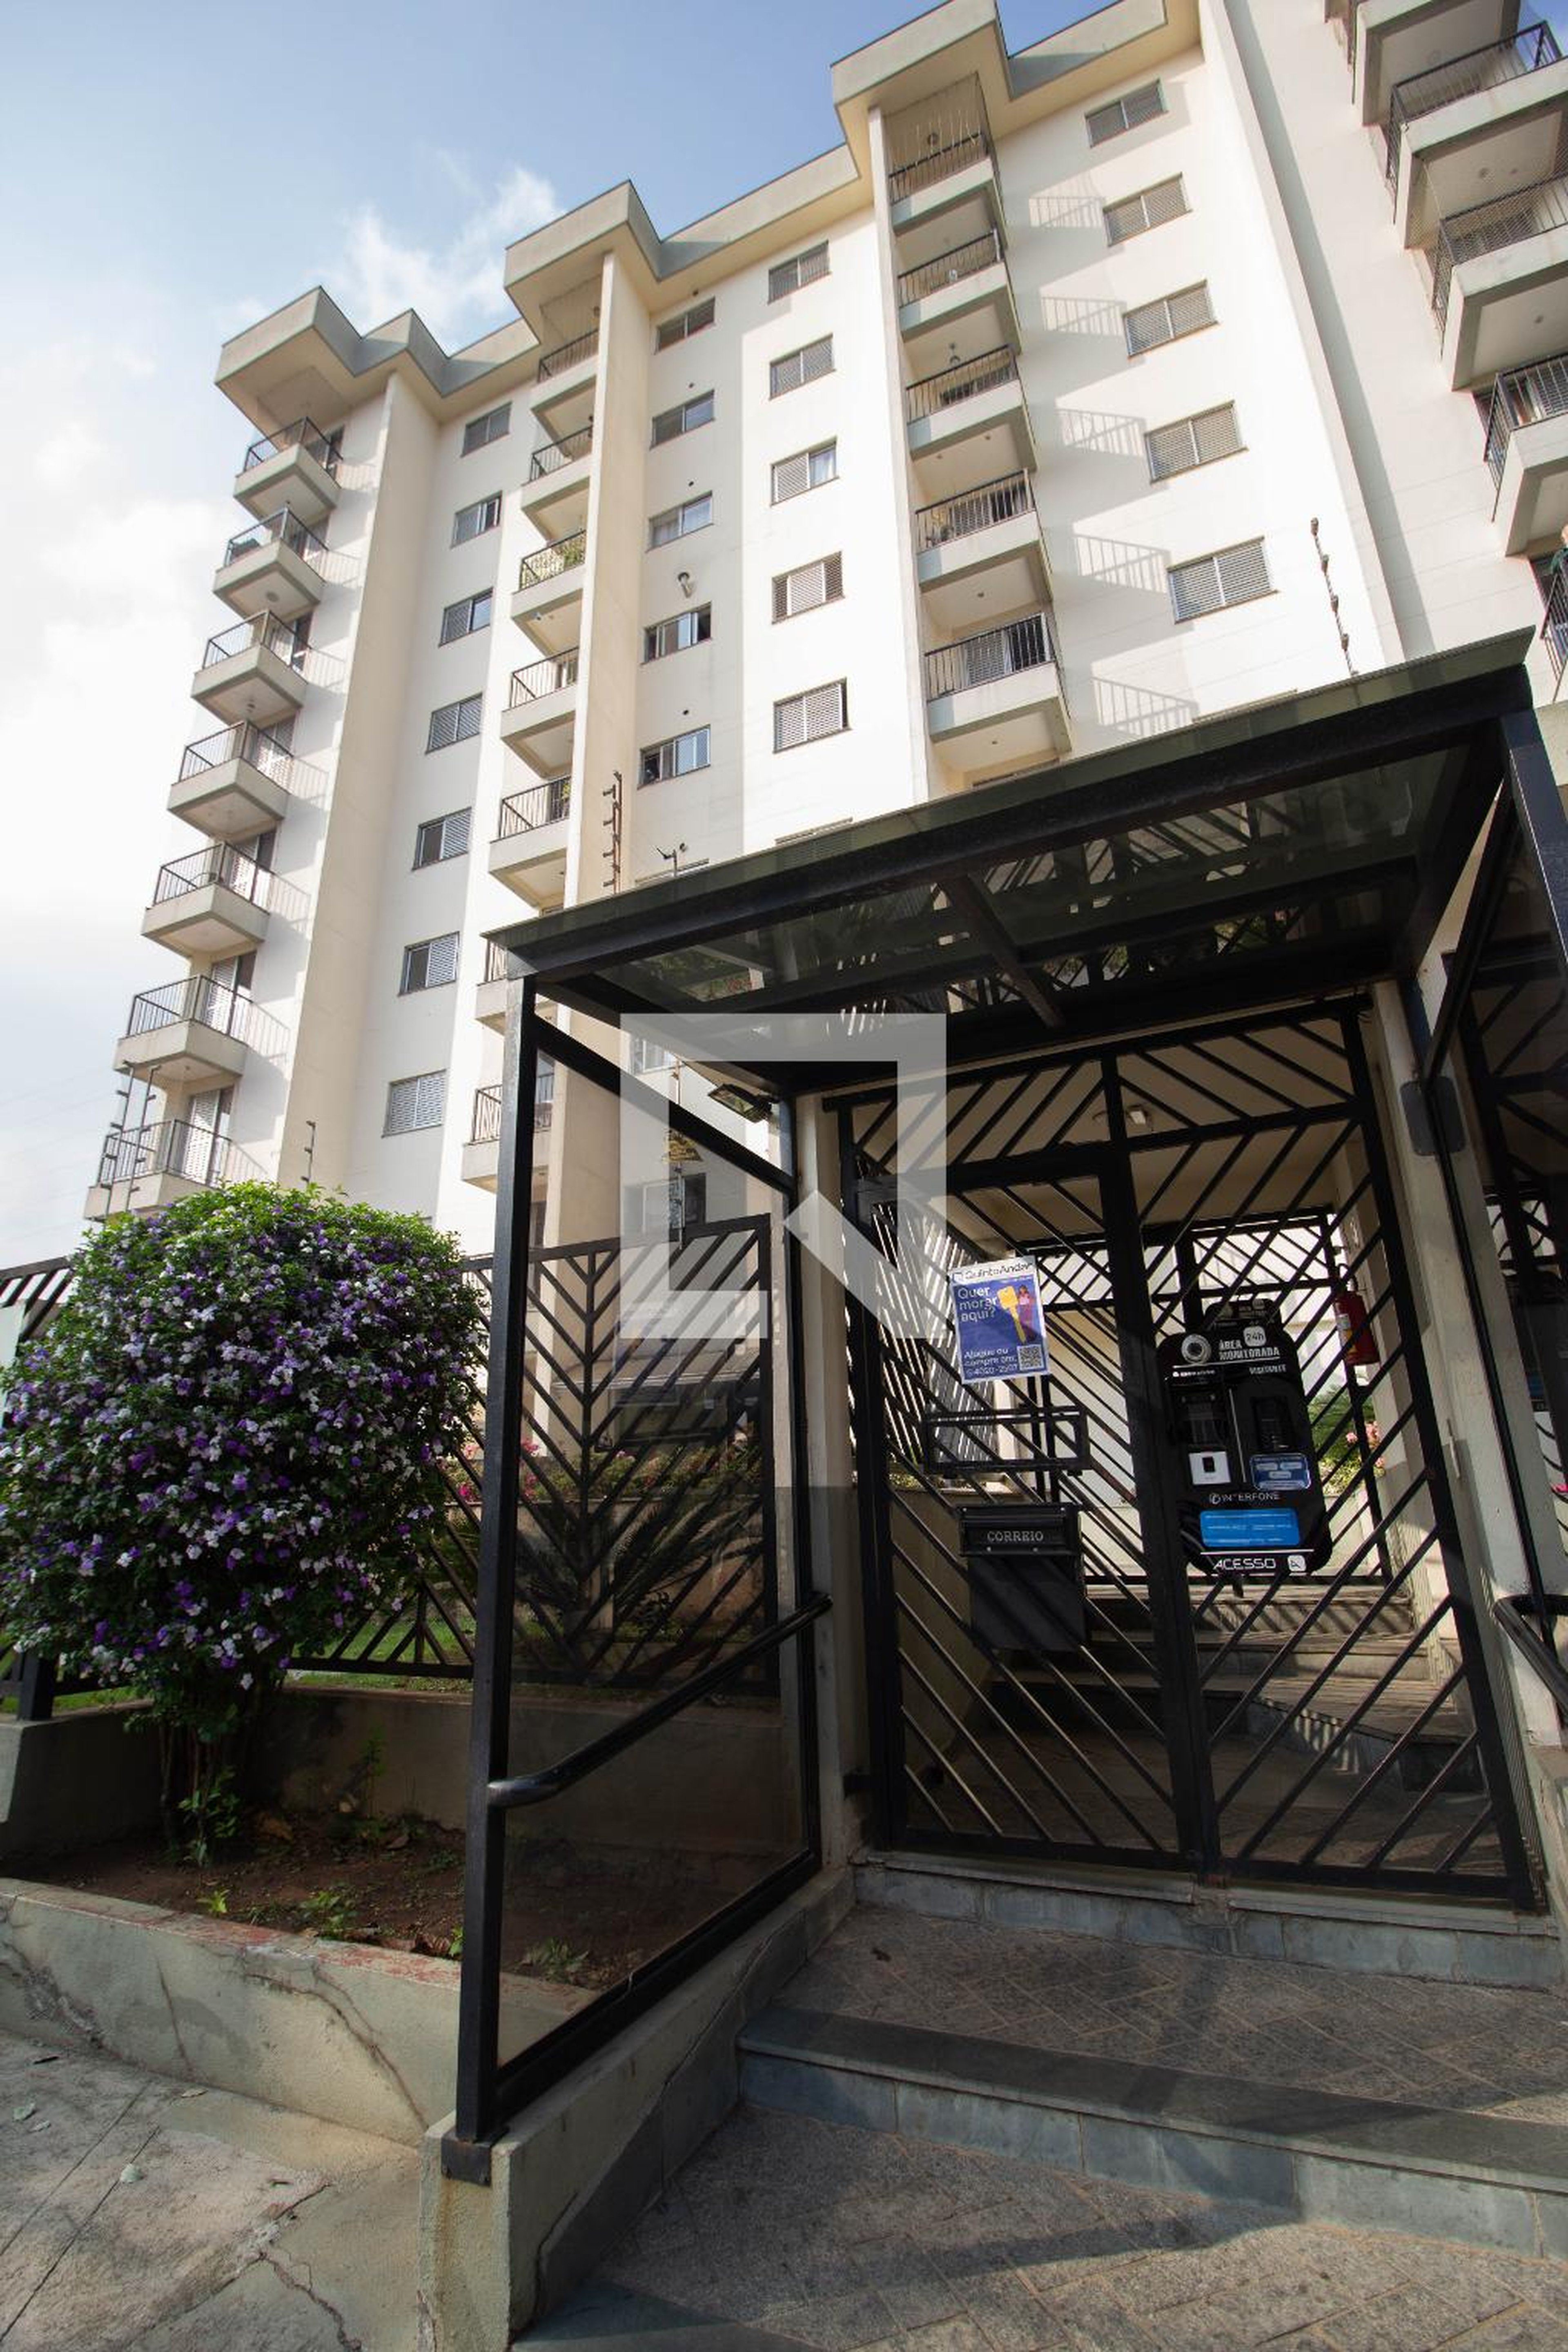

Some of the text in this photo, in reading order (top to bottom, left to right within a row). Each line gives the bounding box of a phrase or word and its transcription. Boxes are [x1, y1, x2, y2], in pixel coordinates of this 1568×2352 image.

[958, 1287, 990, 1299] Quer
[960, 1296, 997, 1310] morar
[961, 1306, 996, 1322] aqui?
[1246, 1331, 1264, 1341] 24h
[987, 1530, 1044, 1542] CORREIO
[1213, 1558, 1276, 1570] ACESSO
